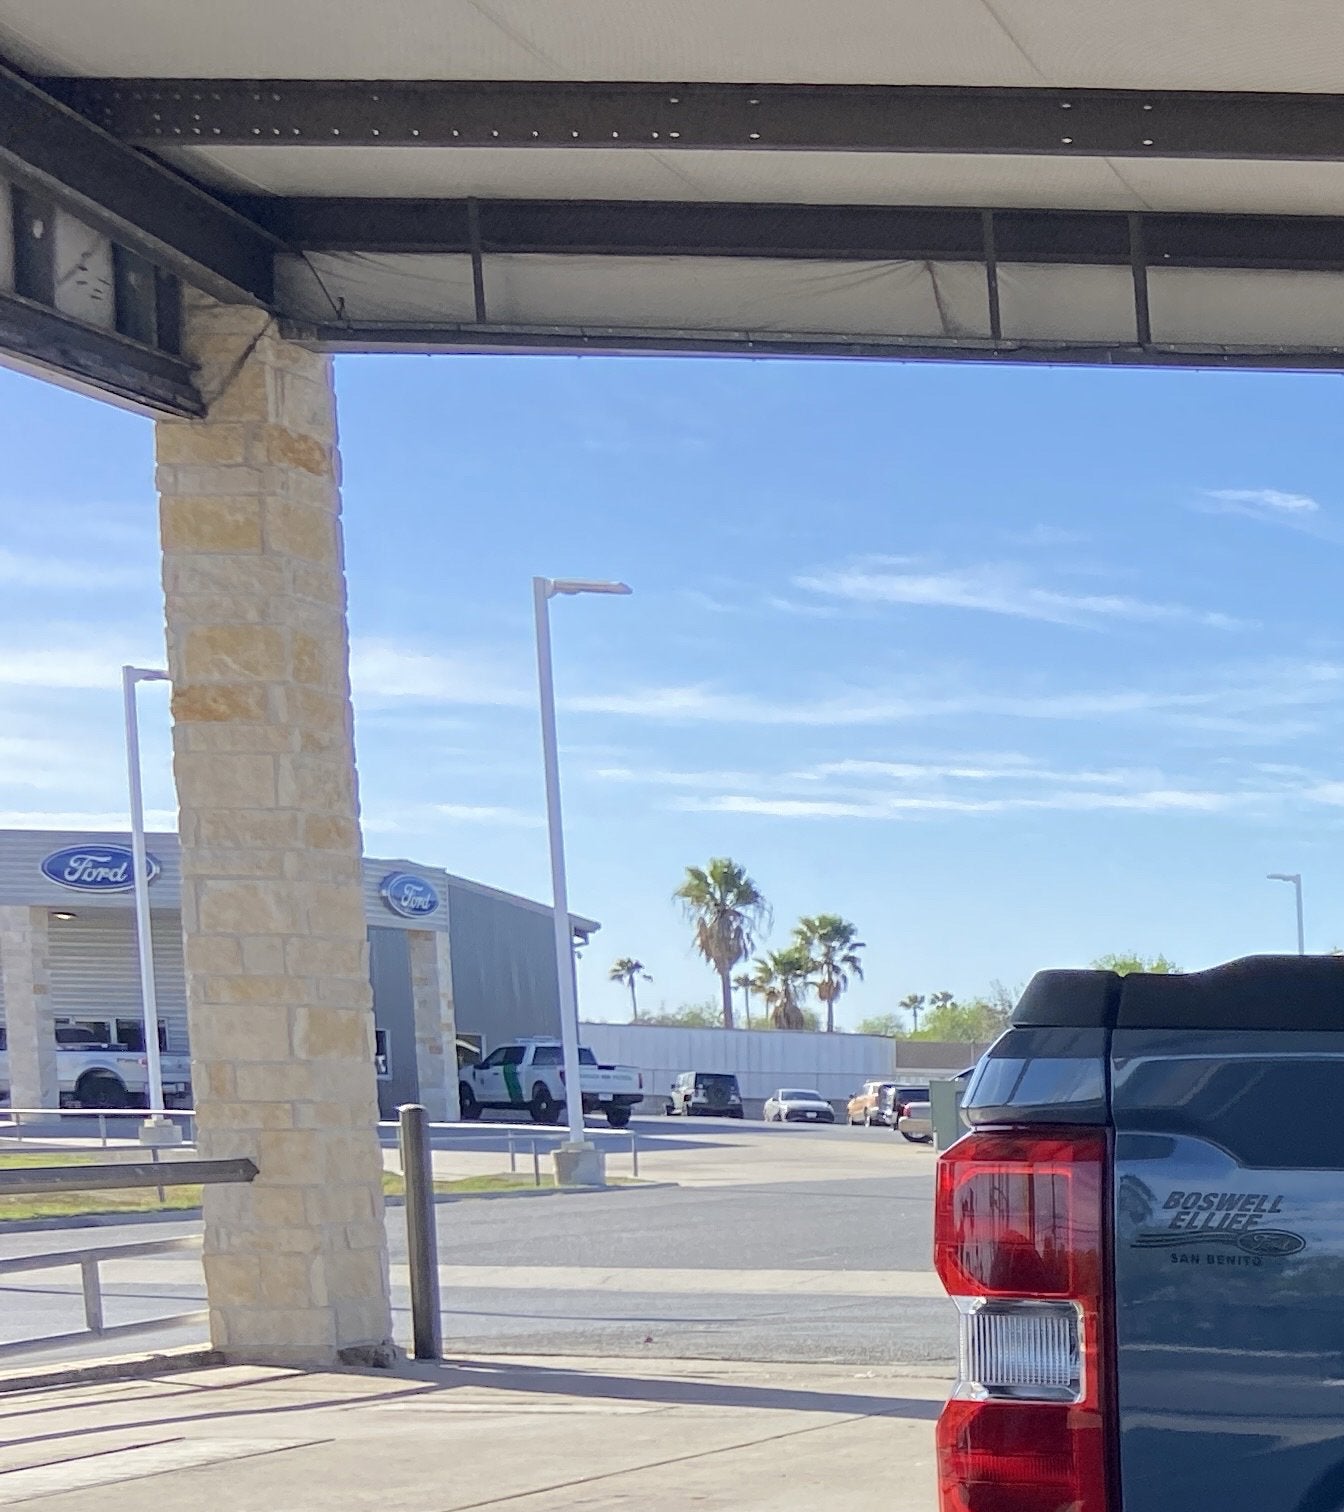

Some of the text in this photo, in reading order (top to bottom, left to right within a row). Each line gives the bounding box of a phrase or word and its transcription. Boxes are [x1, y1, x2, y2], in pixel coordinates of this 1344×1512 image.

[64, 854, 128, 881] Ford
[401, 884, 431, 910] Ford
[1162, 1191, 1284, 1214] BOSWELL
[1168, 1211, 1263, 1232] ELLIFF
[1170, 1253, 1262, 1267] SAN BENITO
